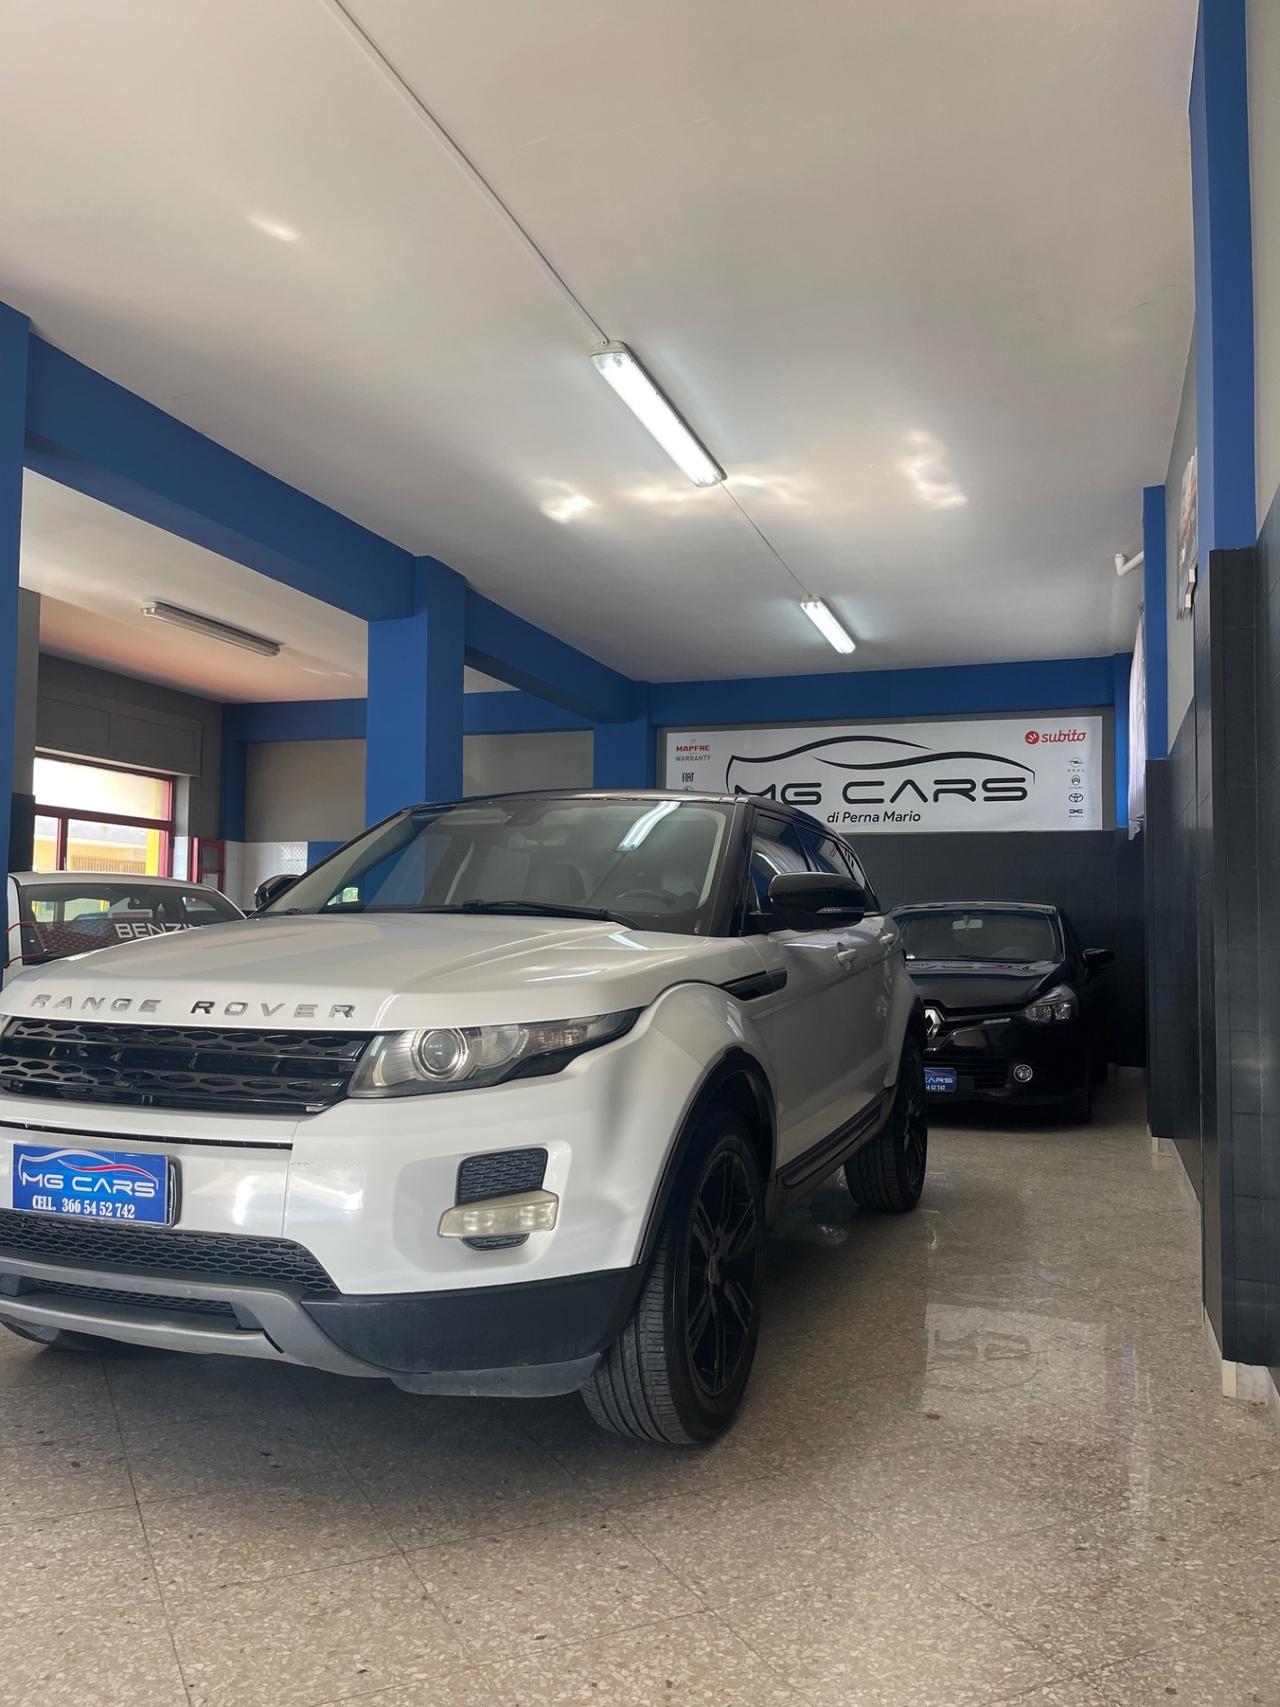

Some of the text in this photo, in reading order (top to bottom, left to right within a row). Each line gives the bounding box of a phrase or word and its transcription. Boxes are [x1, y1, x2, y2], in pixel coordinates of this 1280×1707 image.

[1041, 729, 1087, 743] subito
[682, 772, 694, 782] FIAT
[735, 777, 1027, 805] MG CARS
[827, 811, 921, 823] di Perna Mario
[114, 923, 208, 938] BENZ
[30, 994, 356, 1019] RANGE ROVER
[22, 1172, 155, 1198] MG CARS
[32, 1195, 135, 1218] CELL. 366 54 52 742
